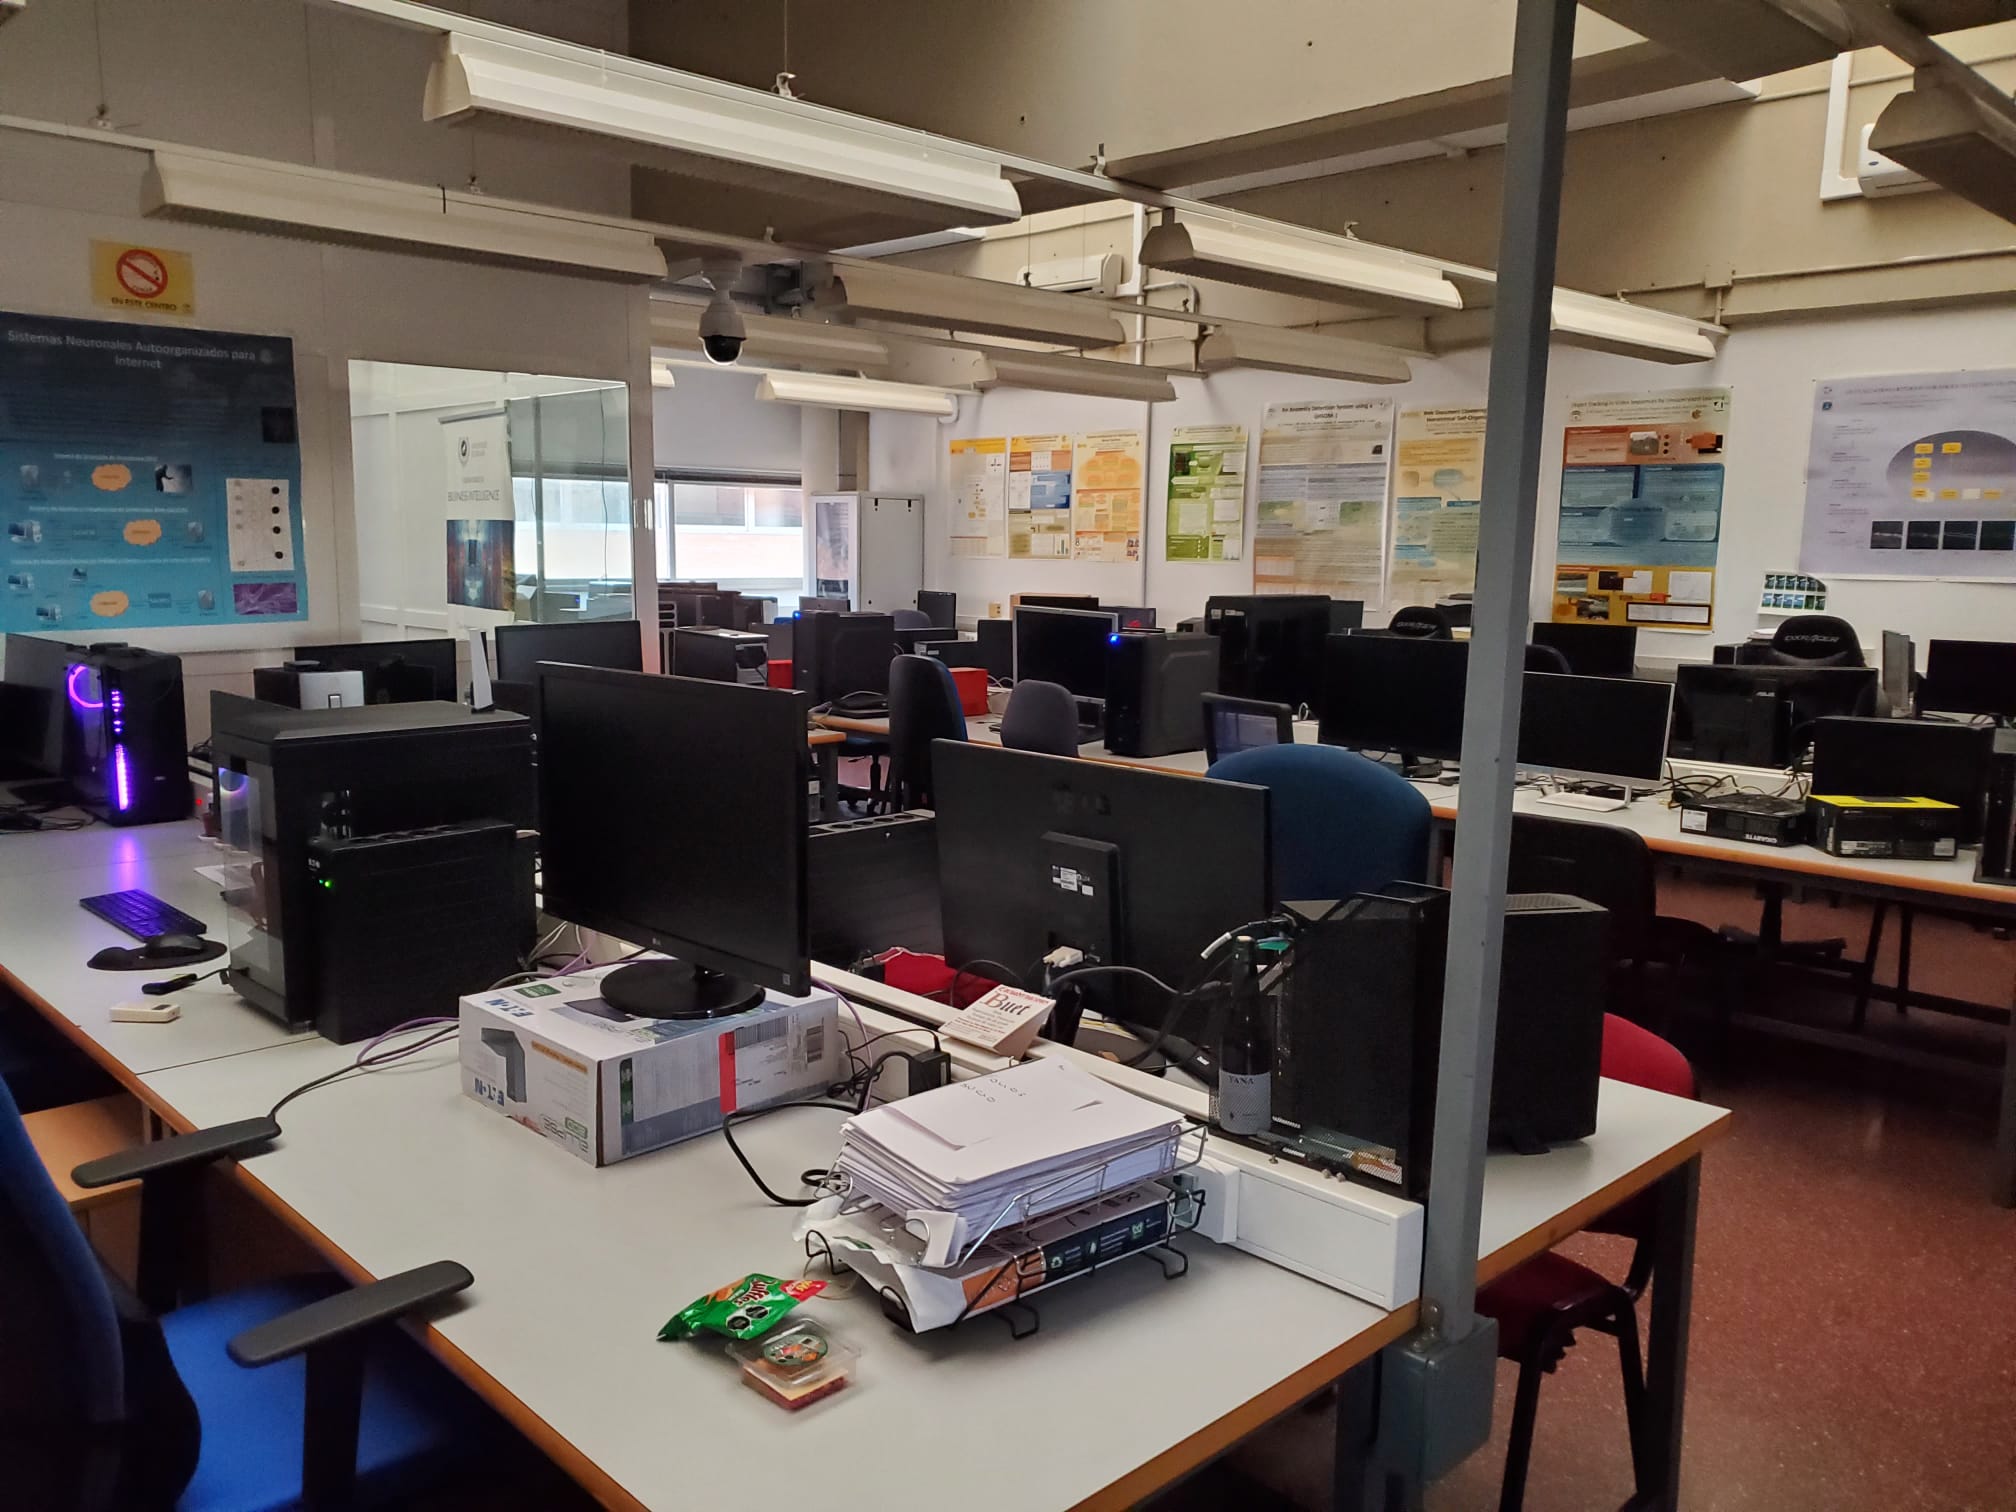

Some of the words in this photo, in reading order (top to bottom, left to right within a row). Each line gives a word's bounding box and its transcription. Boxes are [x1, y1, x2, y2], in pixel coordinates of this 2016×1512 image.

[144, 300, 177, 311] CENTRO
[8, 329, 63, 346] Sistemas
[66, 335, 133, 352] Neuronales
[136, 341, 229, 359] Autoorganizados
[231, 350, 256, 363] para
[115, 355, 162, 370] Internet
